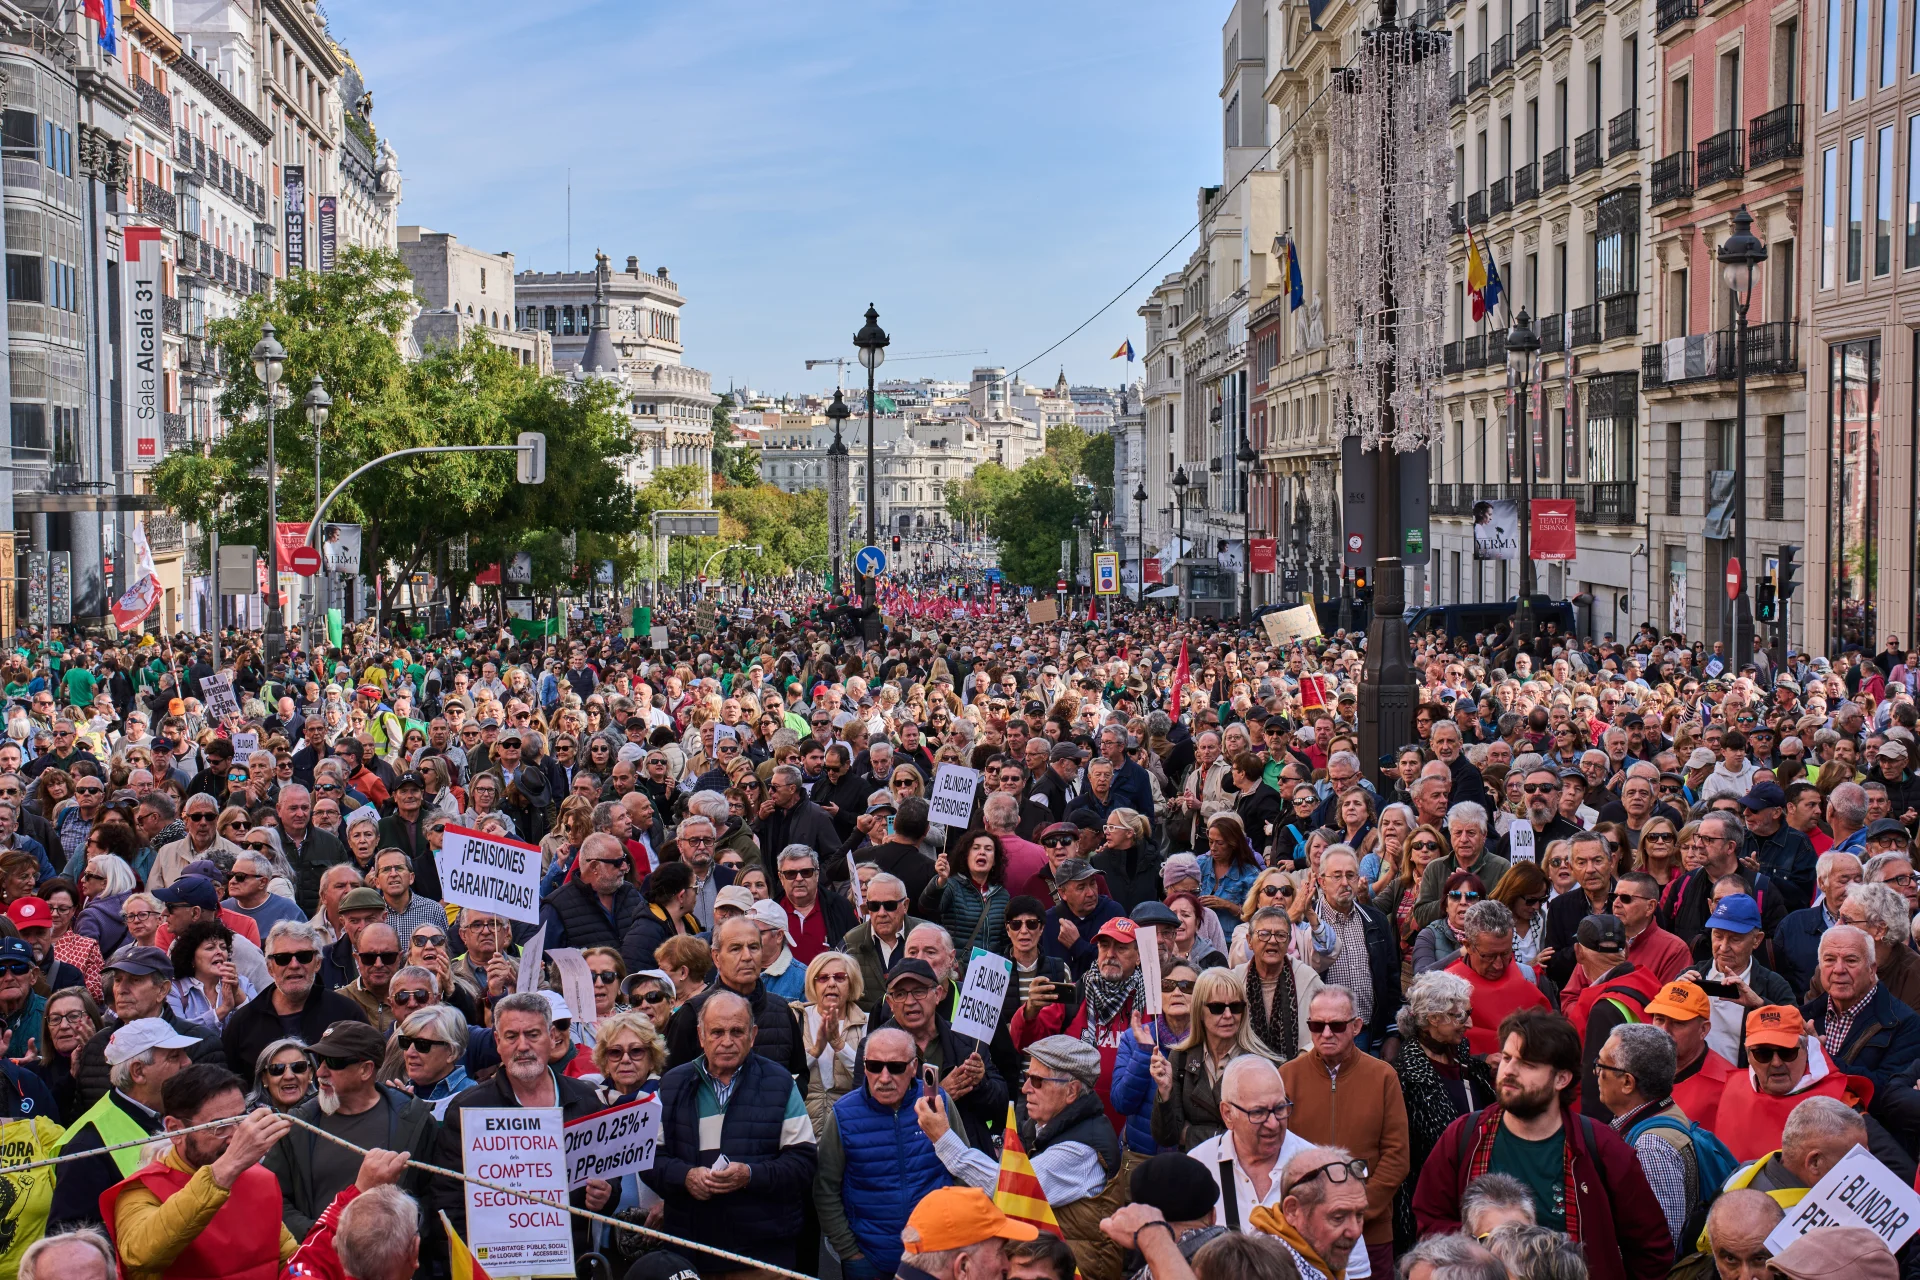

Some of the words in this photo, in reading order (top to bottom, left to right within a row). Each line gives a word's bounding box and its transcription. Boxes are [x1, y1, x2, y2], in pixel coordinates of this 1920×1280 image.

[322, 214, 334, 236] VIVAS
[136, 280, 153, 302] 31
[134, 312, 155, 373] Alcalá
[137, 379, 155, 420] Sala
[1476, 538, 1517, 550] YERMA
[324, 555, 359, 565] YERMA
[207, 676, 219, 686] LA
[203, 682, 231, 698] PENSIÓN
[214, 694, 224, 702] ES
[237, 739, 253, 749] BLINDAR
[233, 752, 250, 762] PENSION
[932, 796, 971, 818] PENSIONES!
[462, 839, 526, 875] ¡PENSIONES
[450, 869, 534, 910] GARANTIZADAS!
[958, 995, 1000, 1030] PENSIONES!
[486, 1118, 541, 1130] EXIGIM
[472, 1136, 558, 1151] AUDITORIA
[575, 1138, 654, 1180] PPensión?
[478, 1163, 553, 1179] COMPTES
[474, 1190, 564, 1207] SEGURETAT
[509, 1212, 564, 1228] SOCIAL
